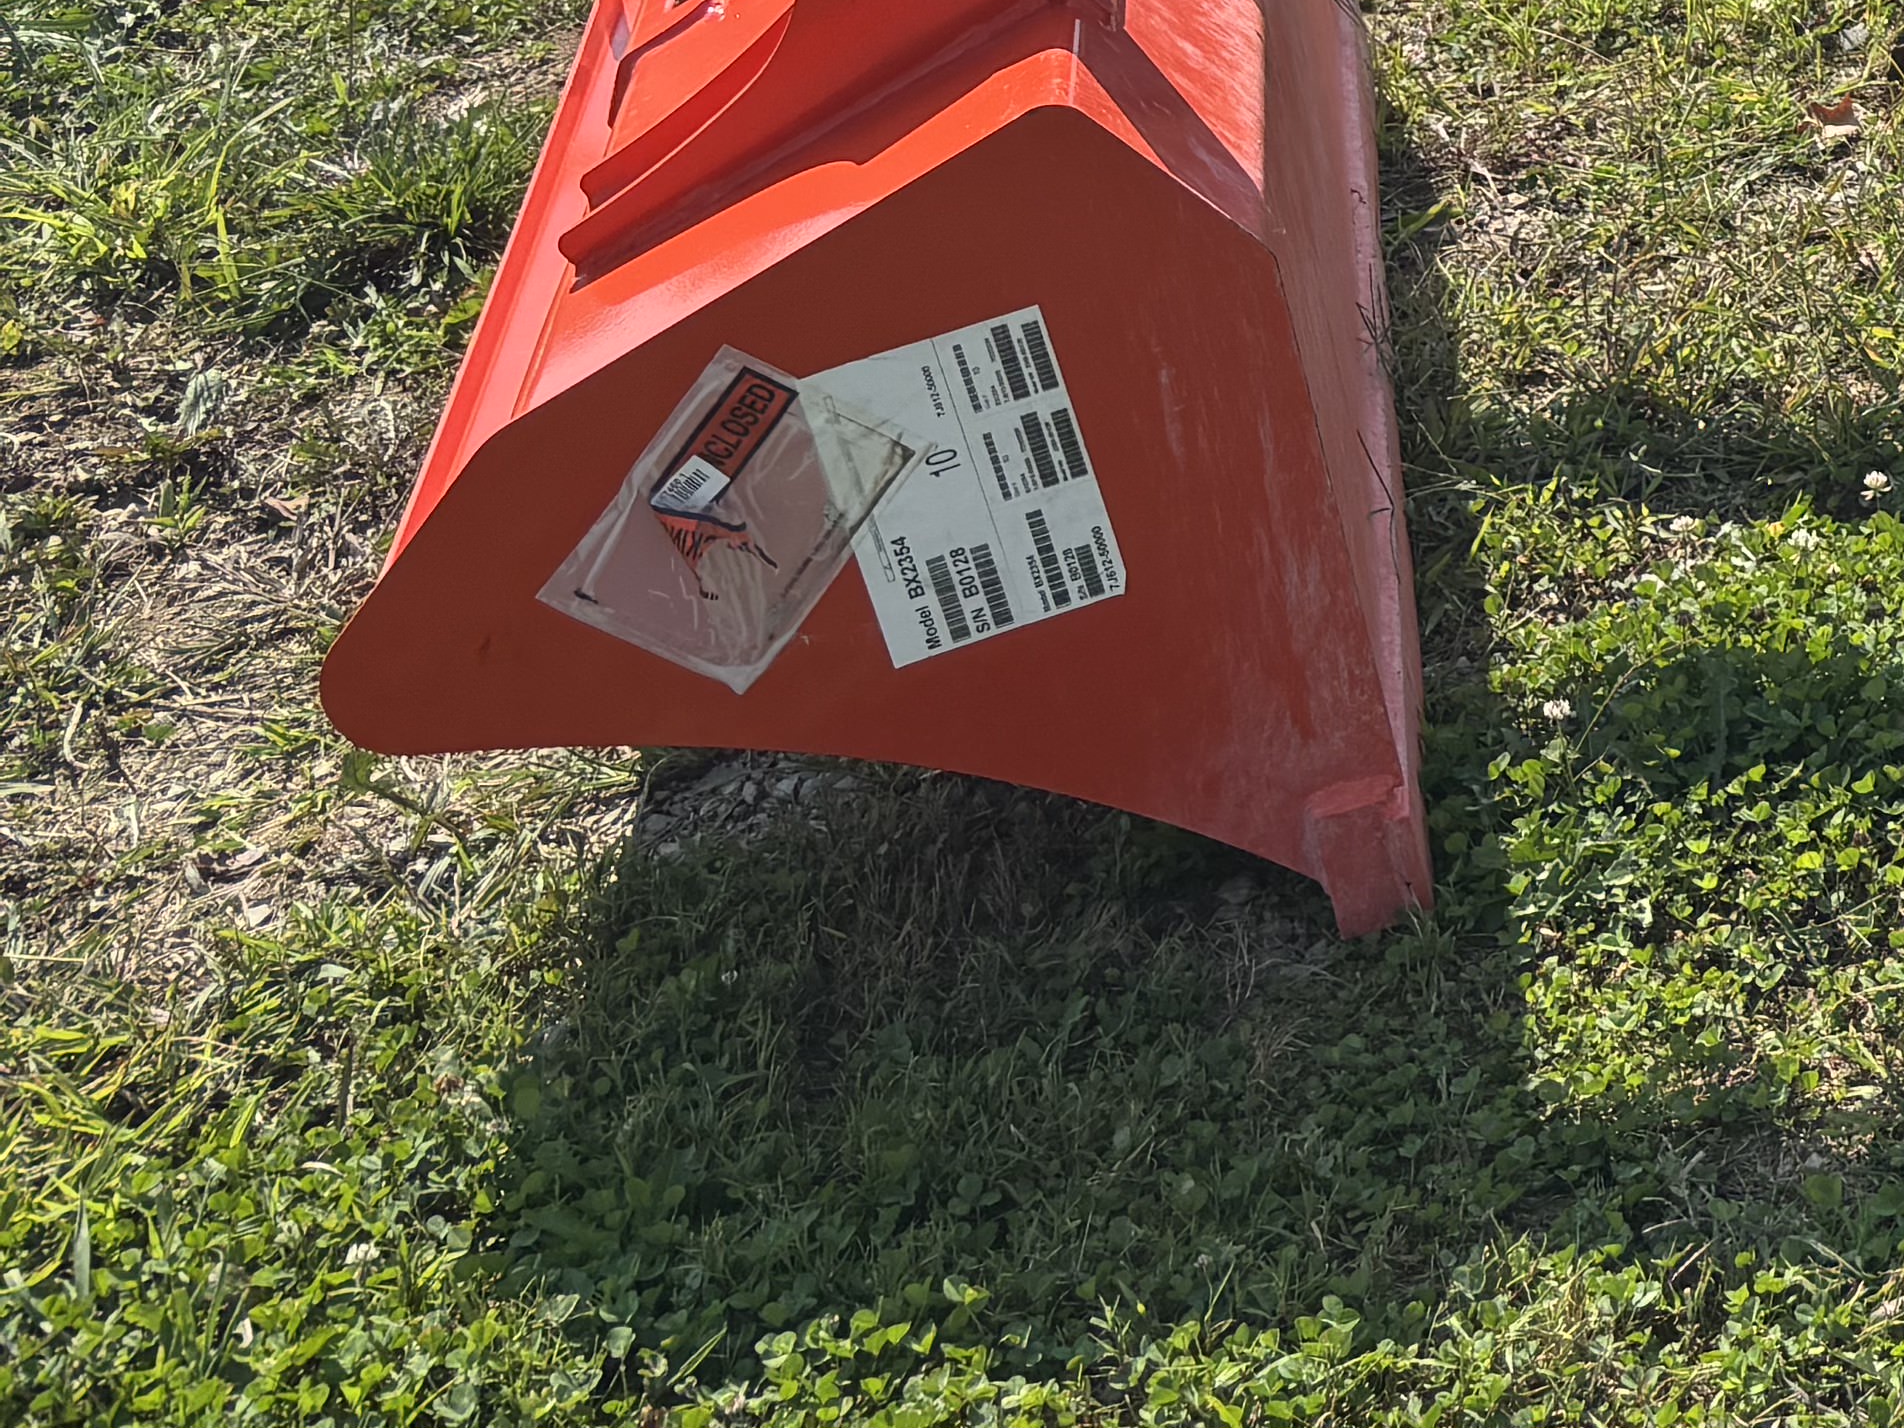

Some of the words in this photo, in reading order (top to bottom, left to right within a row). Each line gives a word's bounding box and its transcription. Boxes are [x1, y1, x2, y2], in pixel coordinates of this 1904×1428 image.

[925, 449, 961, 477] 10
[892, 535, 926, 599] BX2354
[950, 546, 980, 599] B0128
[915, 605, 942, 650] Model
[971, 607, 991, 634] S/N
